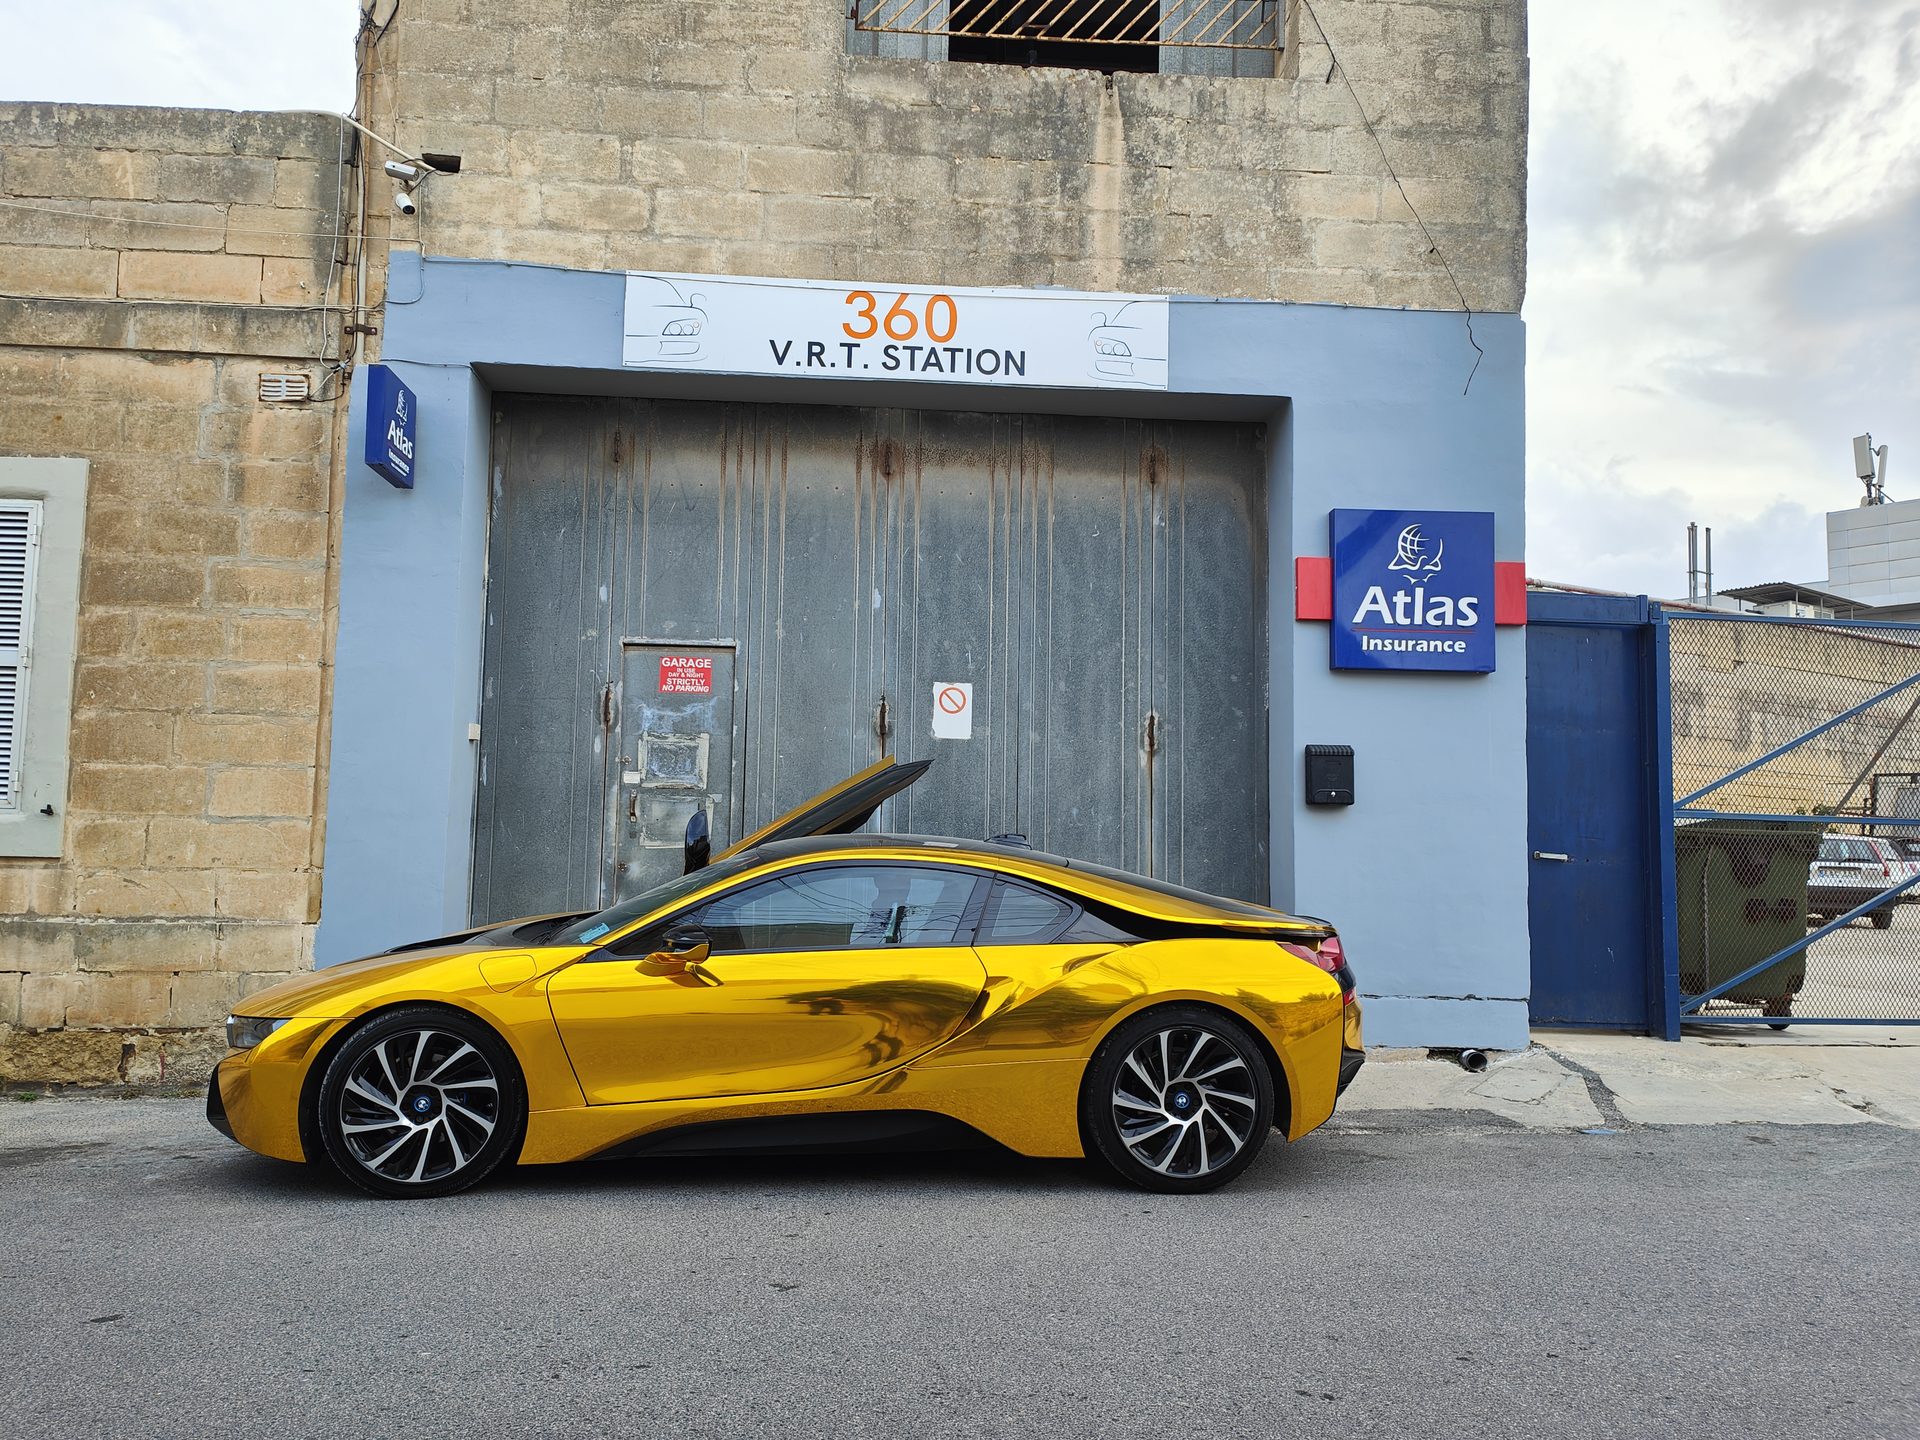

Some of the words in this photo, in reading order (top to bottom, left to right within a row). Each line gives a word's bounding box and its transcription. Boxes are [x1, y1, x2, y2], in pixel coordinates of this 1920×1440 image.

[842, 290, 958, 343] 360
[769, 339, 869, 370] V.R.T.
[881, 344, 1026, 377] STATION
[387, 419, 413, 460] Atlas
[388, 447, 409, 473] Insurance
[1352, 586, 1479, 627] Atlas
[662, 658, 711, 668] GARAGE
[1361, 635, 1467, 653] Insurance
